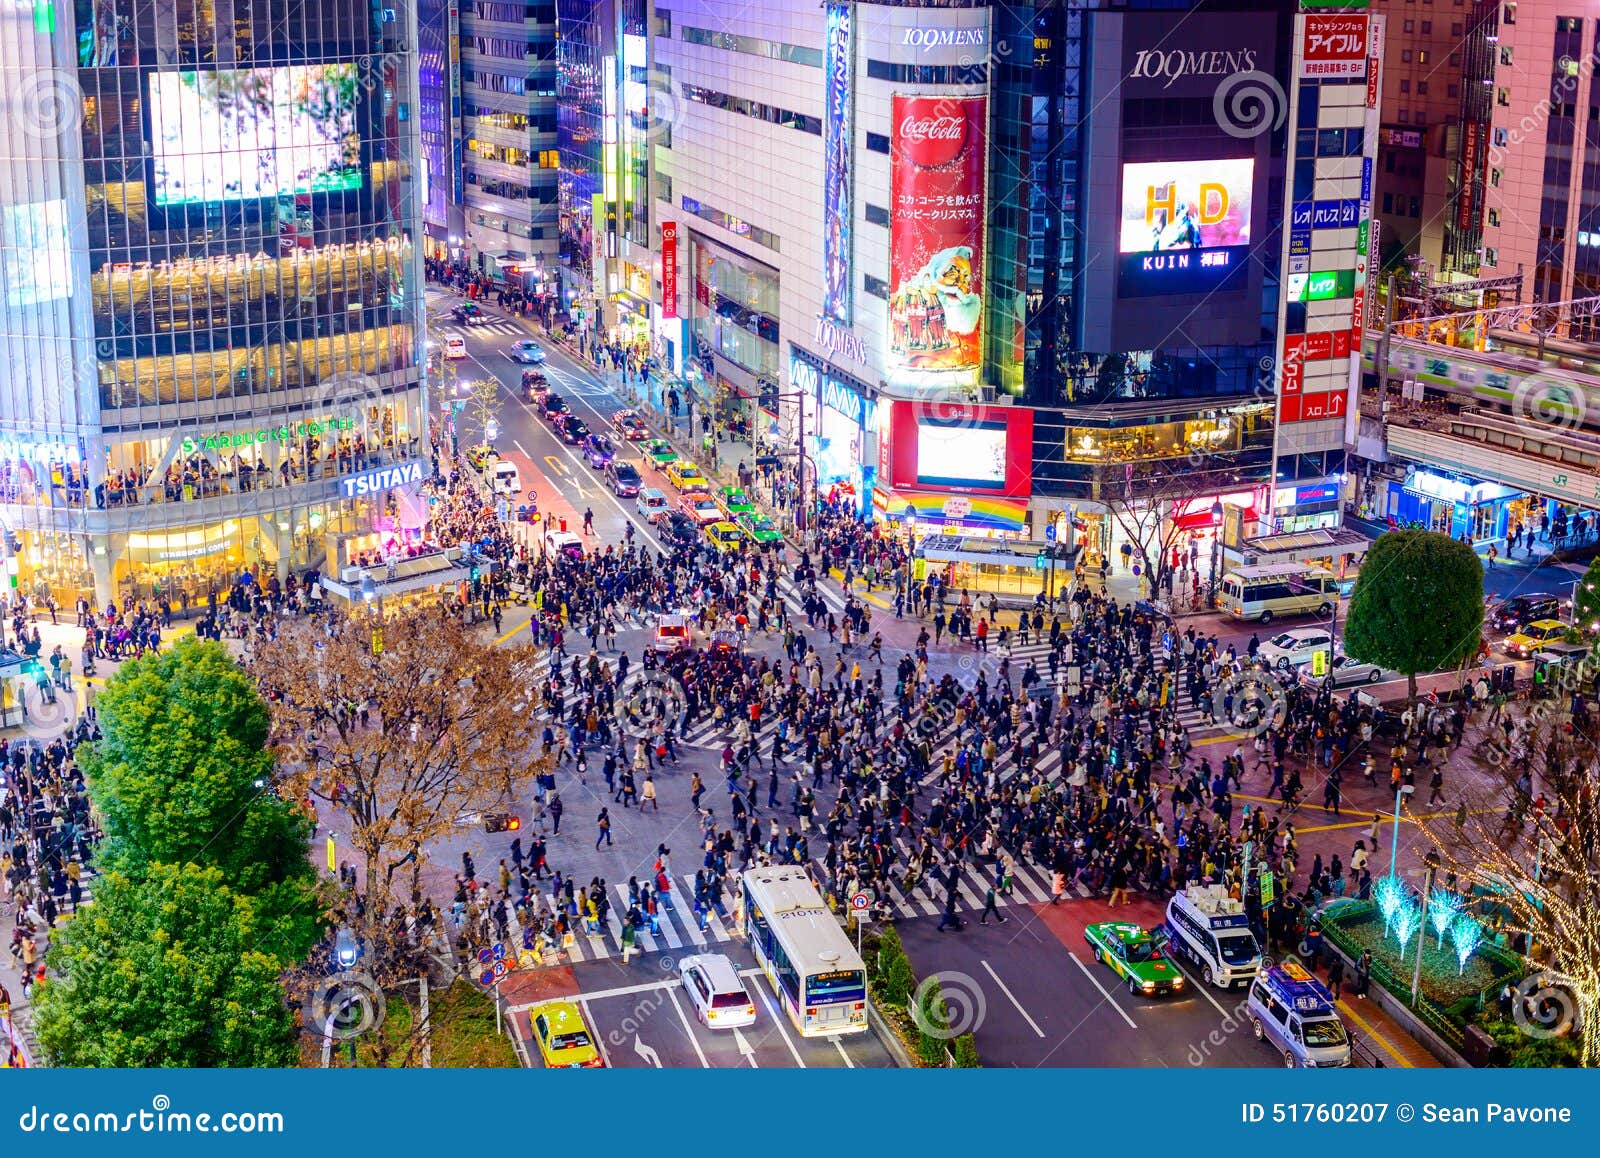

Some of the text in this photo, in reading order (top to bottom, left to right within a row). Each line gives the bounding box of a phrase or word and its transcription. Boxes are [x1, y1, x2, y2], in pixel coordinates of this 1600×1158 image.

[1308, 22, 1363, 32] キャッシングなら
[1308, 34, 1364, 53] アイフル
[833, 13, 851, 115] WINTER
[1130, 47, 1257, 88] 109MEN'S
[1305, 63, 1363, 74] 新規会員募集中 8F
[1367, 70, 1377, 103] アイフル
[899, 115, 965, 140] Coca-Cola
[1294, 206, 1355, 225] レオパレス21
[1359, 226, 1367, 249] レイク
[1143, 254, 1190, 270] KUIN
[1309, 280, 1336, 293] レイク
[1353, 296, 1363, 328] アコム
[1285, 347, 1301, 391] アコム
[1307, 406, 1323, 417] 入口
[183, 417, 356, 453] STARBUCKS COFFEE
[344, 462, 423, 496] TSUTAYA
[781, 910, 824, 919] 21016
[1296, 996, 1319, 1009] 聖書
